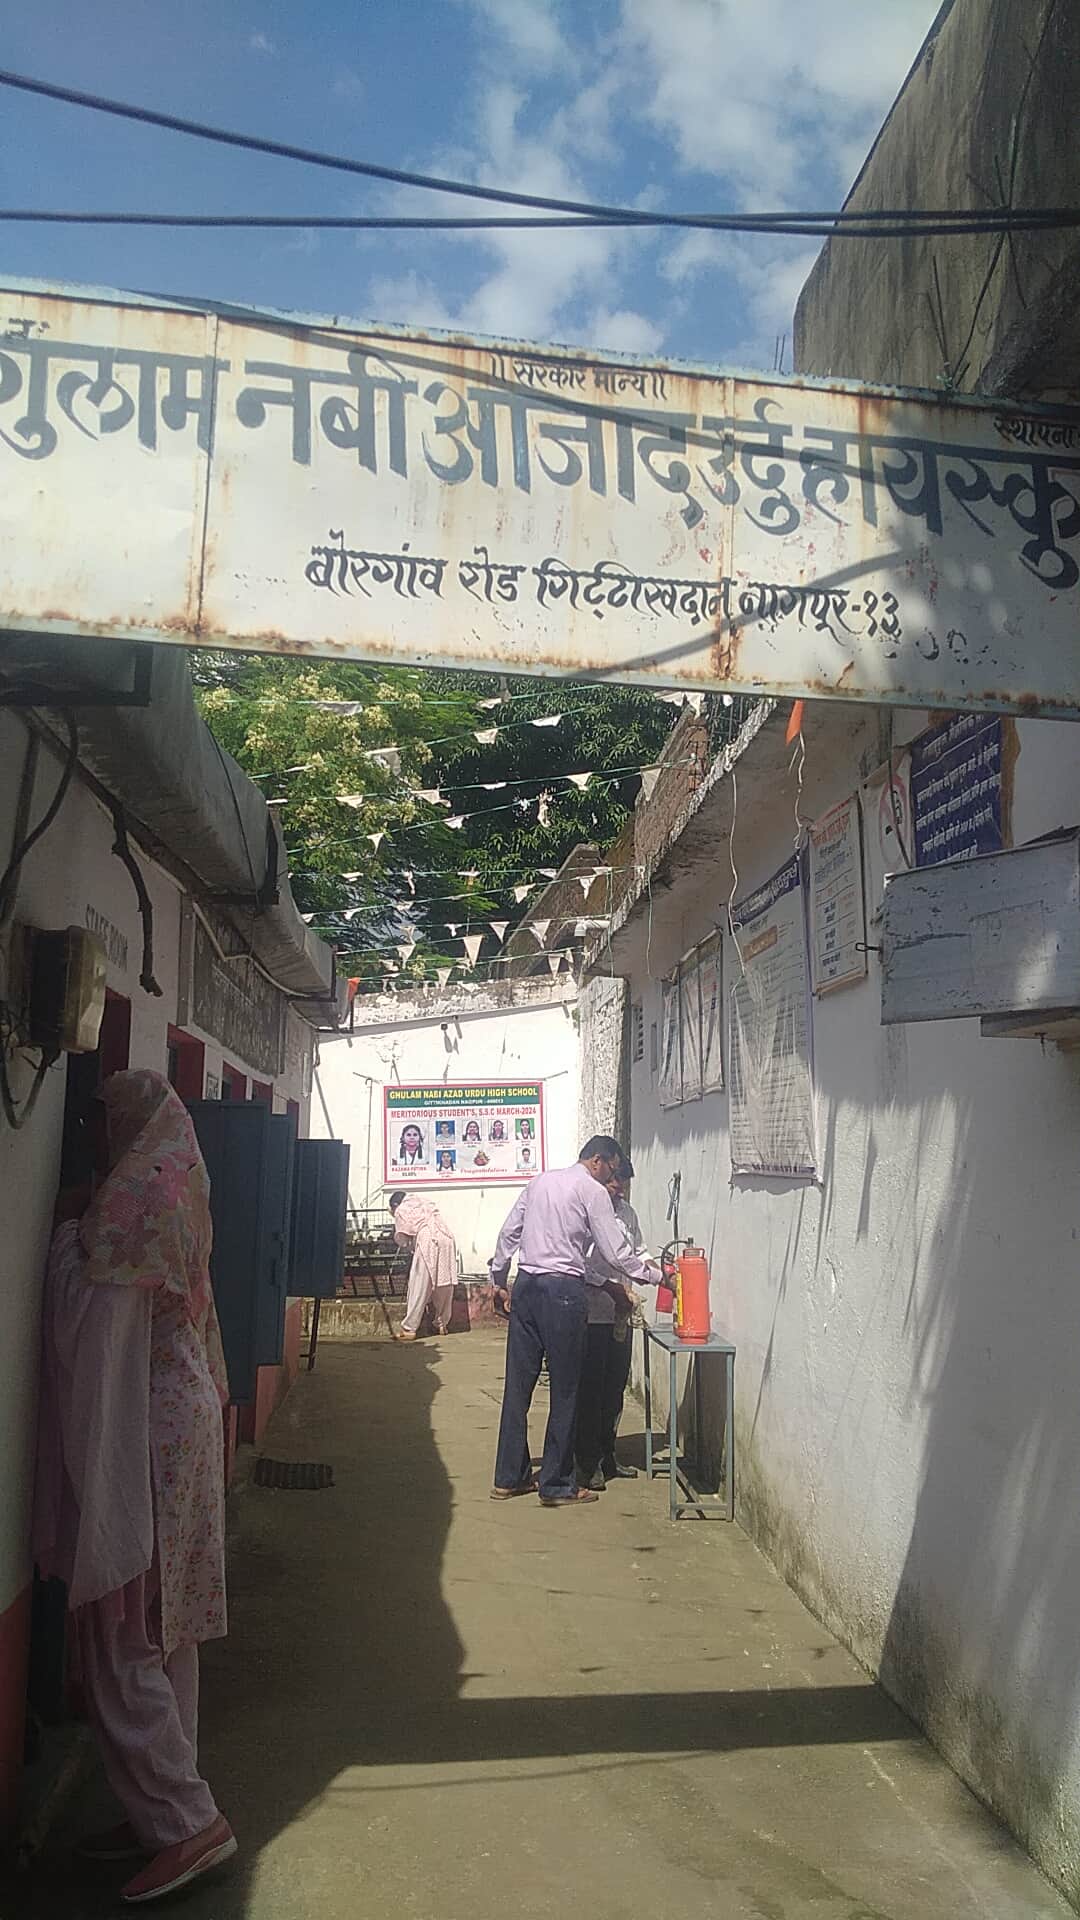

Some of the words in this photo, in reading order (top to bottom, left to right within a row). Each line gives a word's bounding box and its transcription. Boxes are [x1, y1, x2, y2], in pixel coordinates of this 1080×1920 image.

[513, 359, 586, 392] सरकार
[236, 350, 418, 480] नबी
[458, 546, 527, 604] रोड
[389, 1090, 422, 1099] GHULAM
[423, 1089, 442, 1099] NABI
[443, 1089, 464, 1099] AZAD
[464, 1088, 486, 1098] URDU
[487, 1087, 506, 1097] HIGH
[507, 1086, 538, 1097] SCHOOL
[391, 1109, 438, 1119] MERITORIOUS
